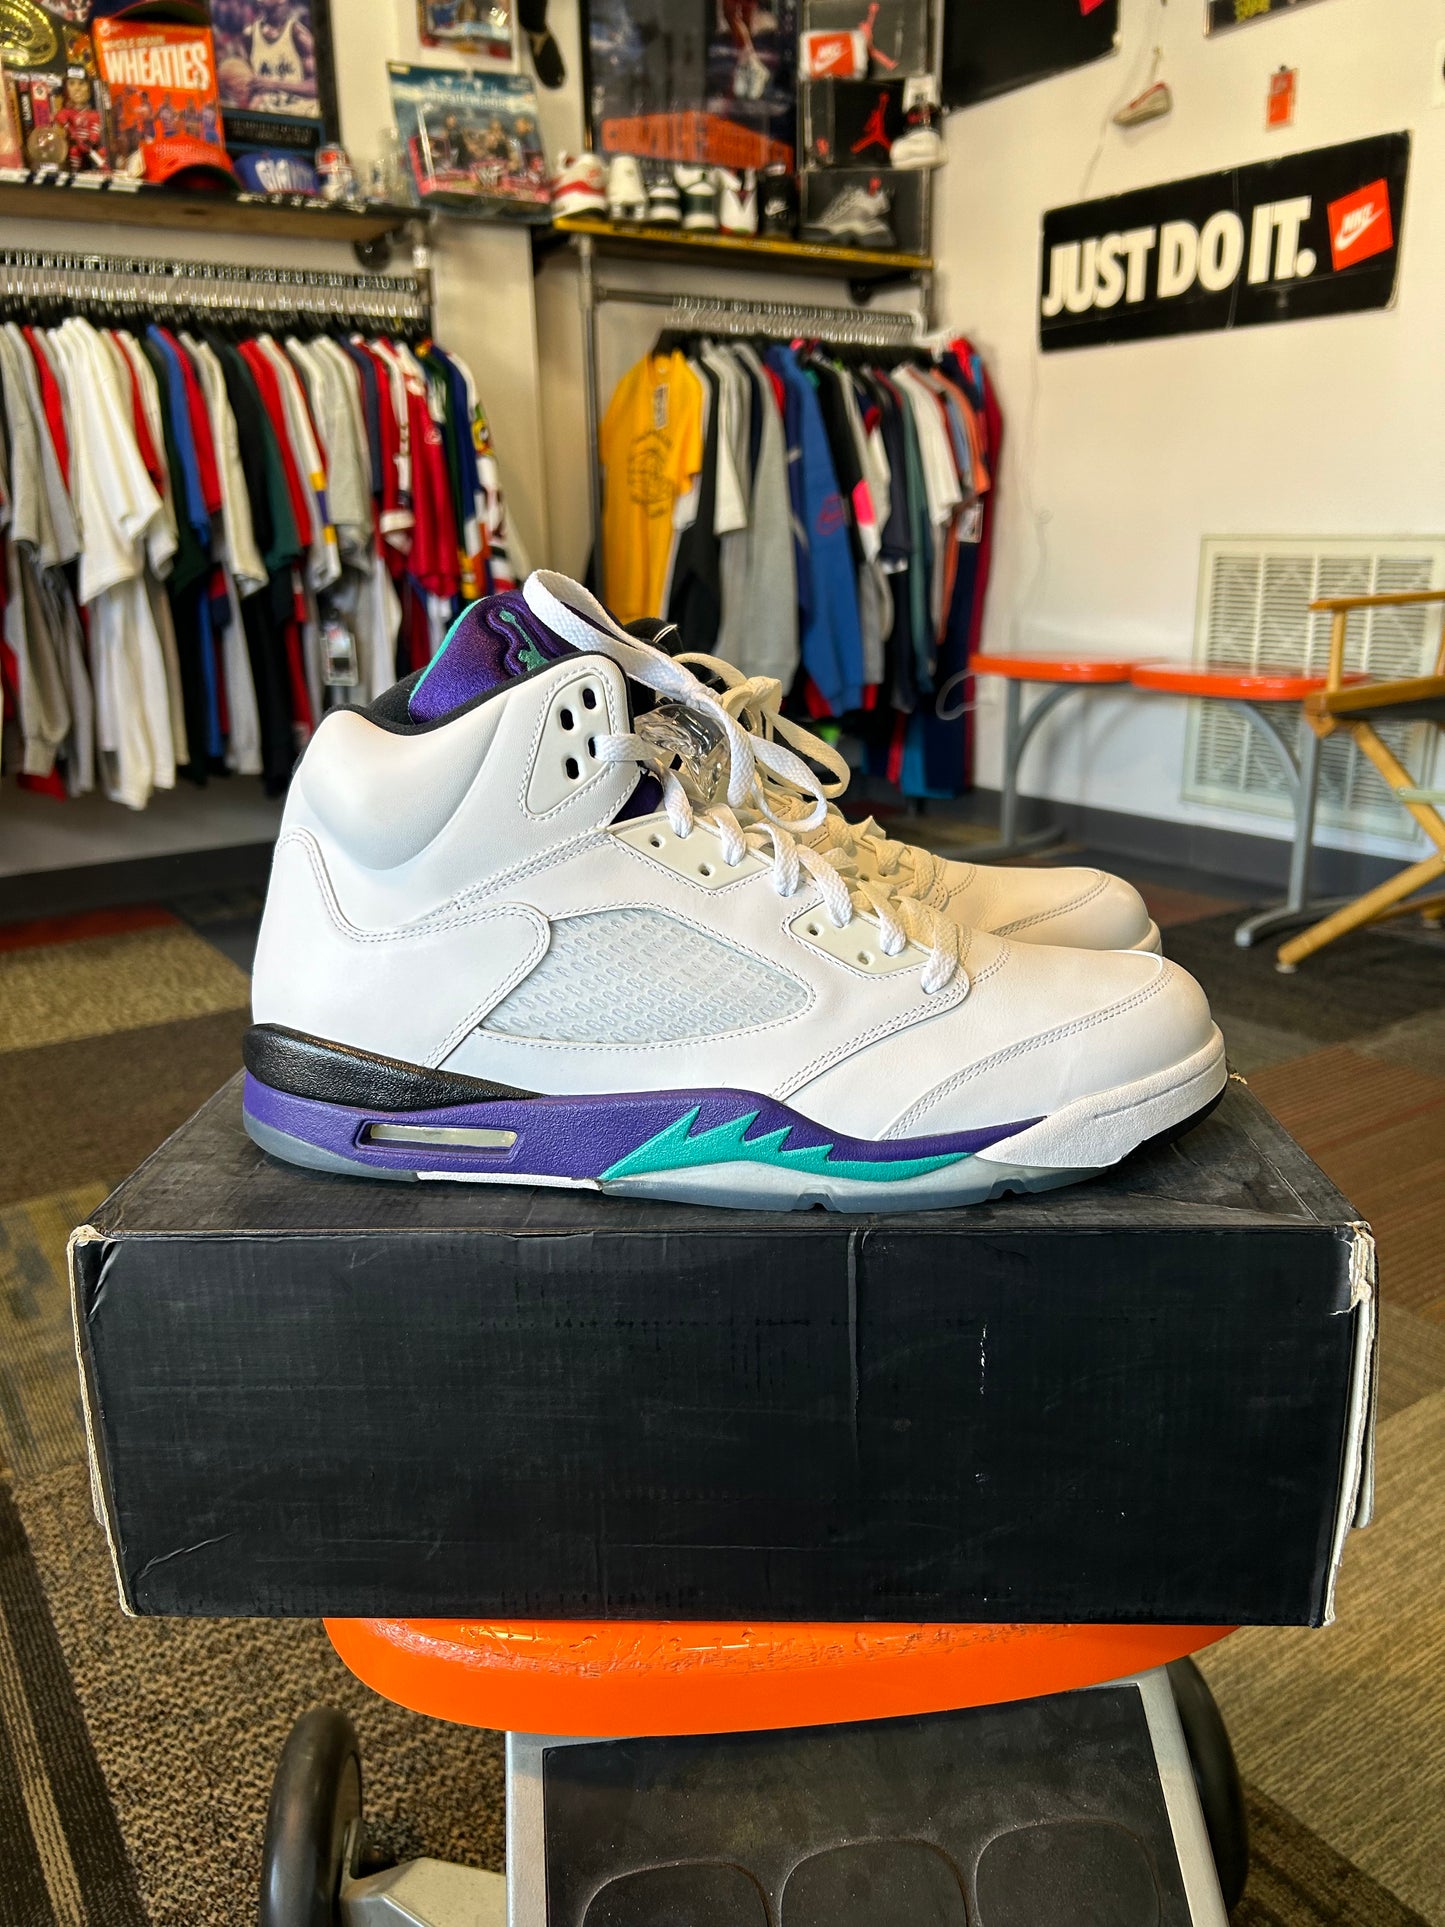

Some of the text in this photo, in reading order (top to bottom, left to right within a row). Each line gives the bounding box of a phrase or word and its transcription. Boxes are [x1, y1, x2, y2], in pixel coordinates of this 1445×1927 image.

[103, 41, 209, 91] WHEATIES
[1041, 195, 1317, 317] JUST DO IT.
